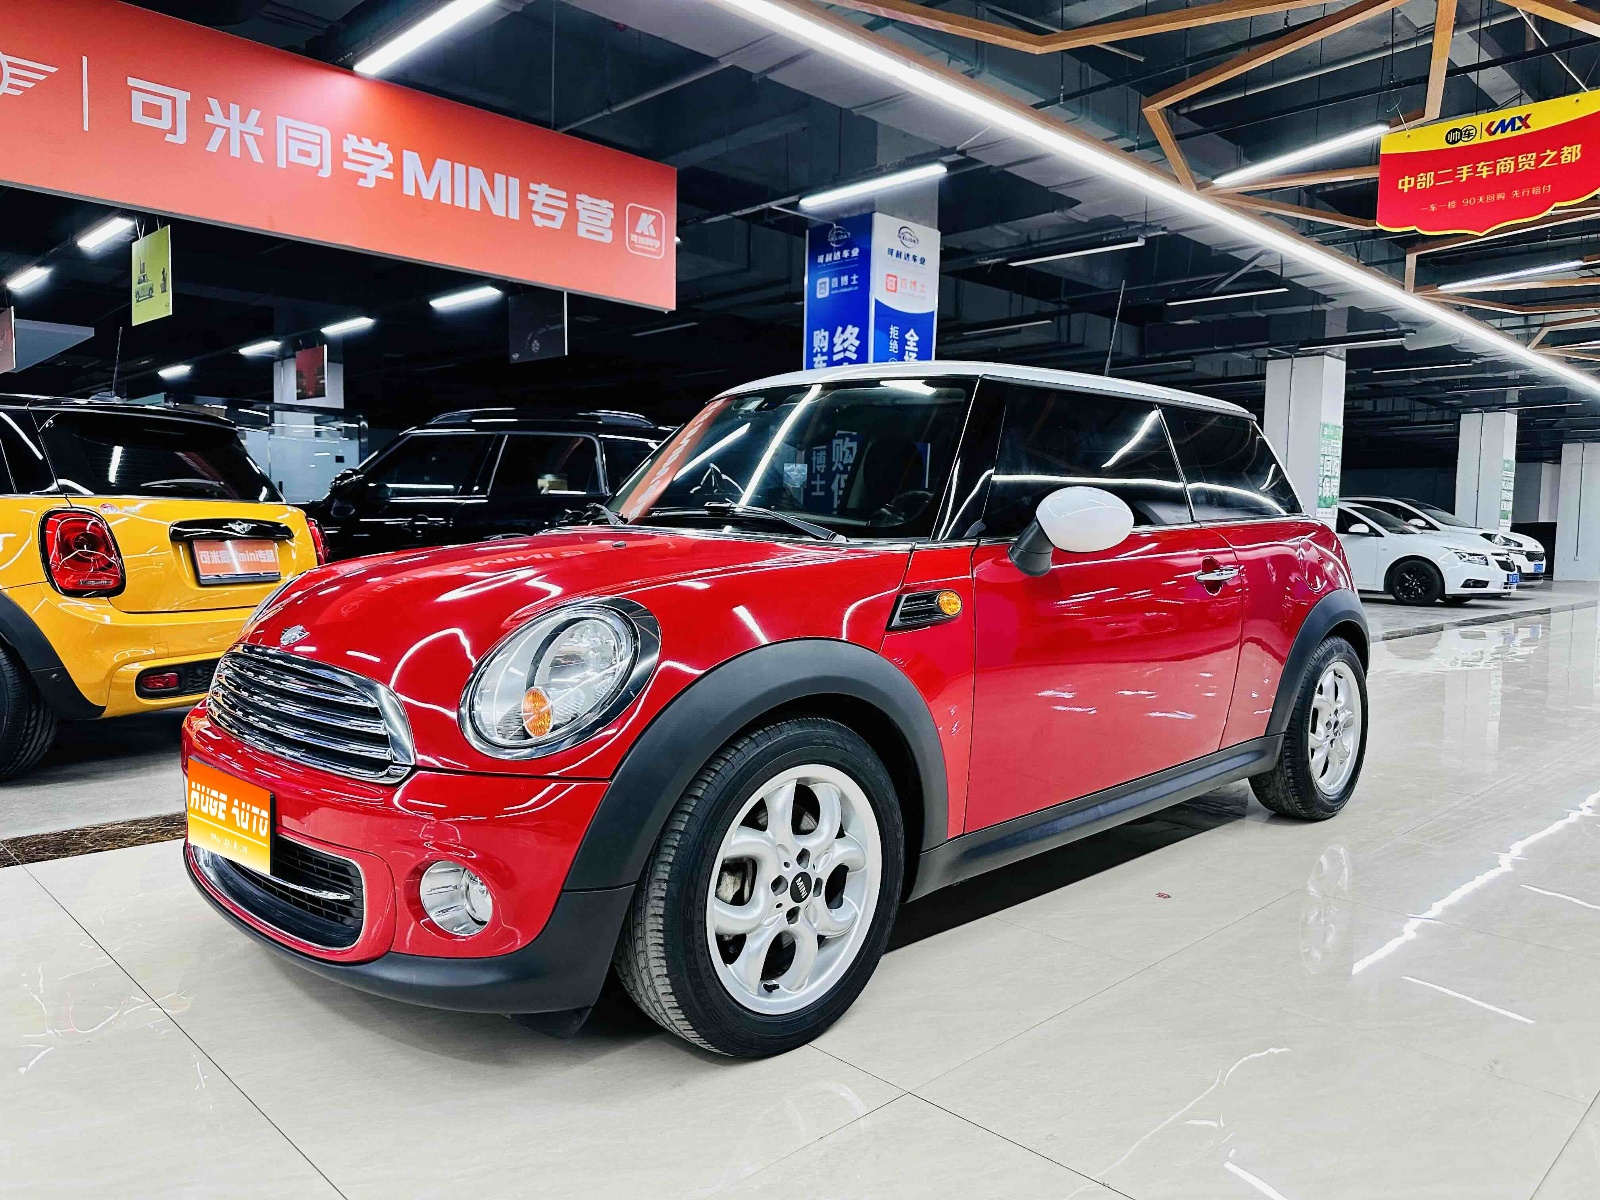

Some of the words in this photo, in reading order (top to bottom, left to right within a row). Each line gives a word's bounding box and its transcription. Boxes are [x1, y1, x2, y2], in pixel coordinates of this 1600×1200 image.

[1446, 126, 1476, 144] 帅车
[1485, 113, 1532, 136] KMX
[127, 76, 615, 244] 可米同学MINI专营
[1397, 144, 1582, 193] 中部二手车商贸之都
[1419, 200, 1457, 212] 一车一检
[1462, 192, 1506, 207] 90天回购
[833, 324, 860, 365] 终
[795, 876, 808, 899] MINI
